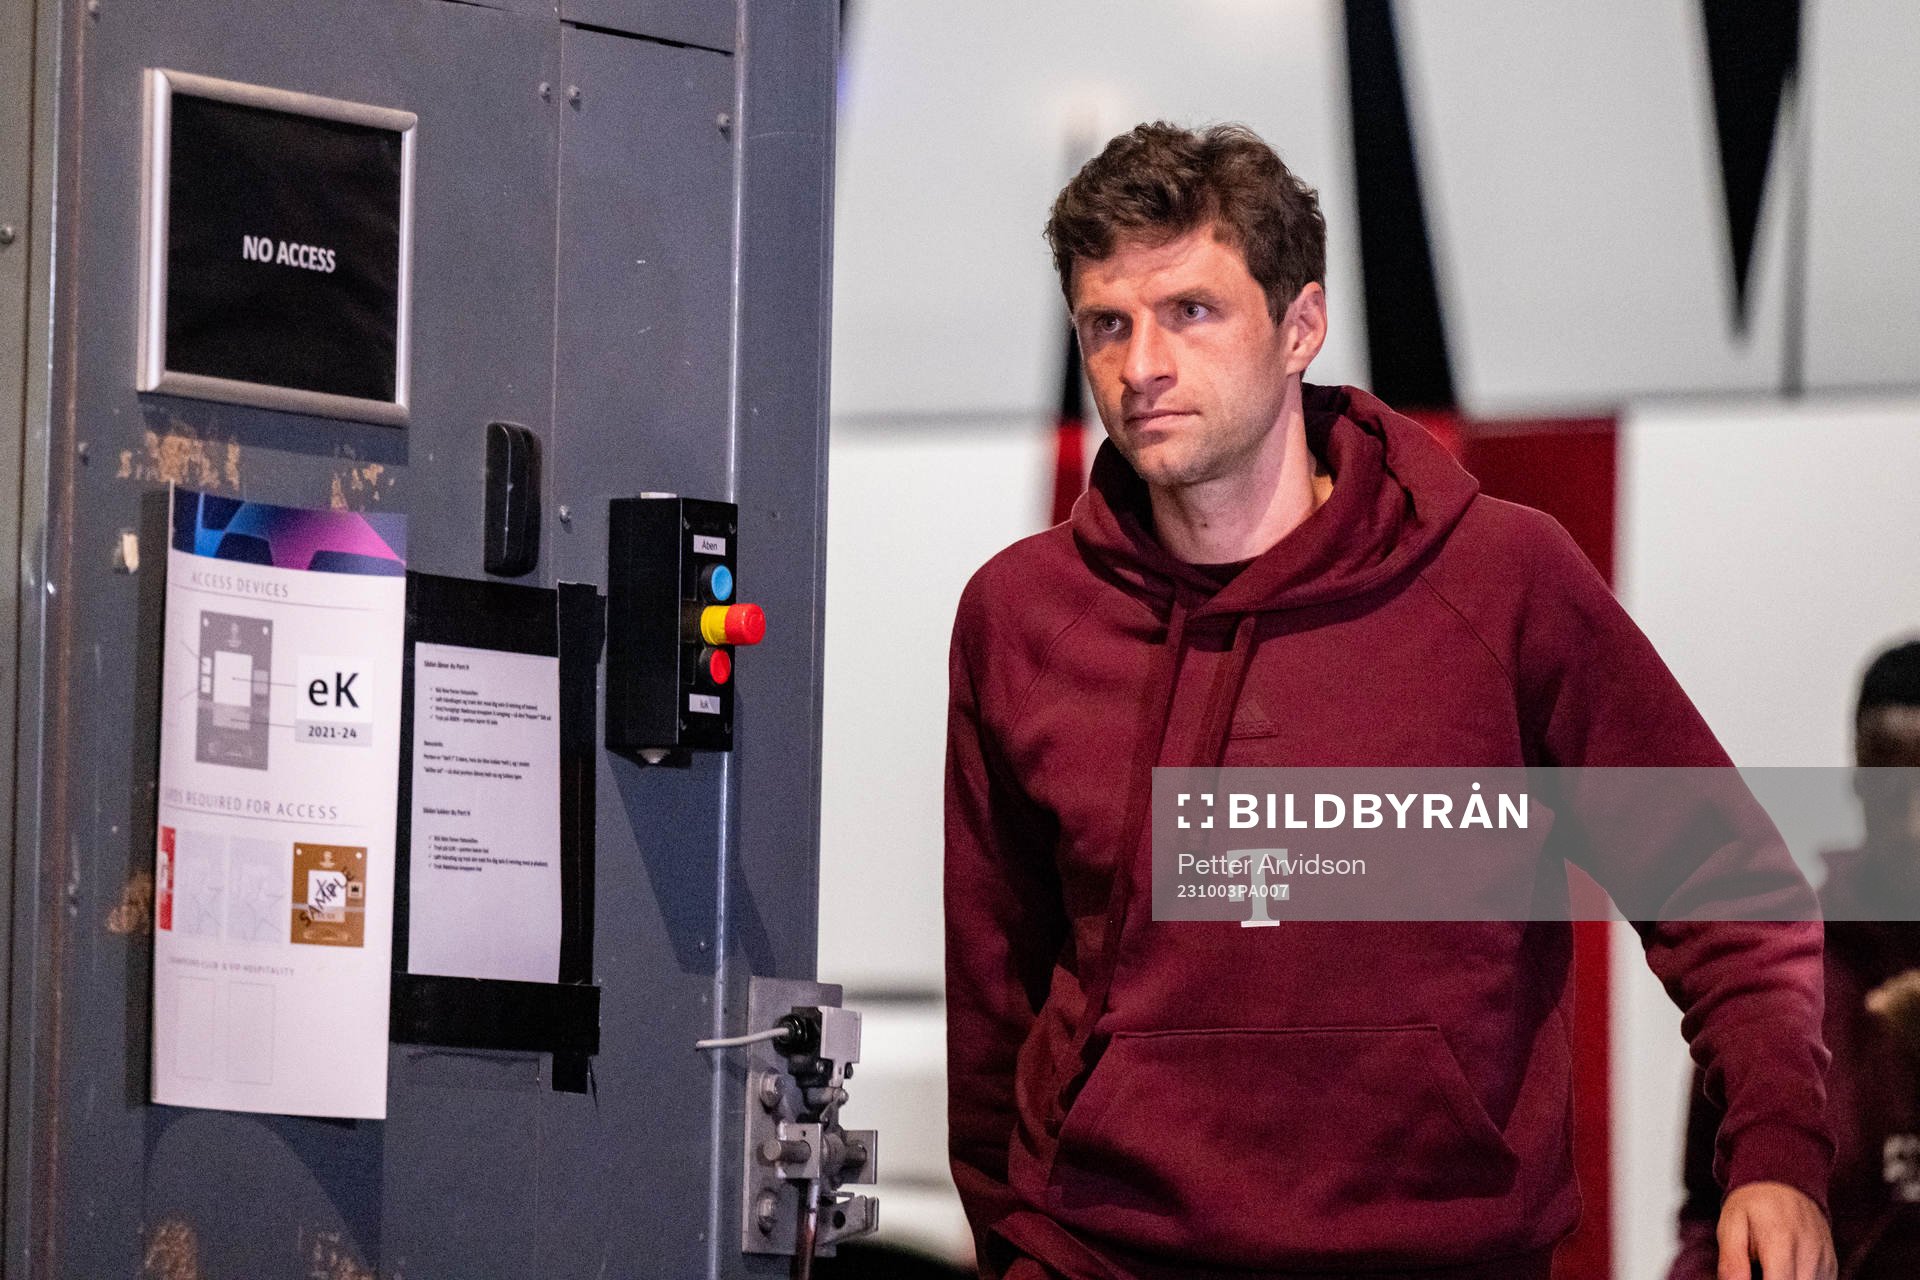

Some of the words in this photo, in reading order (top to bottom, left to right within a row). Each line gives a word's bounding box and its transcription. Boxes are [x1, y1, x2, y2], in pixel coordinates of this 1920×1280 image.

[243, 235, 273, 263] NO
[276, 241, 336, 273] ACCESS
[192, 571, 232, 591] ACCESS
[236, 577, 289, 598] DEVICES
[308, 672, 360, 709] eK
[308, 725, 358, 740] 2021-24
[186, 791, 242, 812] REQUIRED
[246, 799, 271, 815] FOR
[276, 803, 338, 820] ACCESS
[1227, 848, 1289, 927] T
